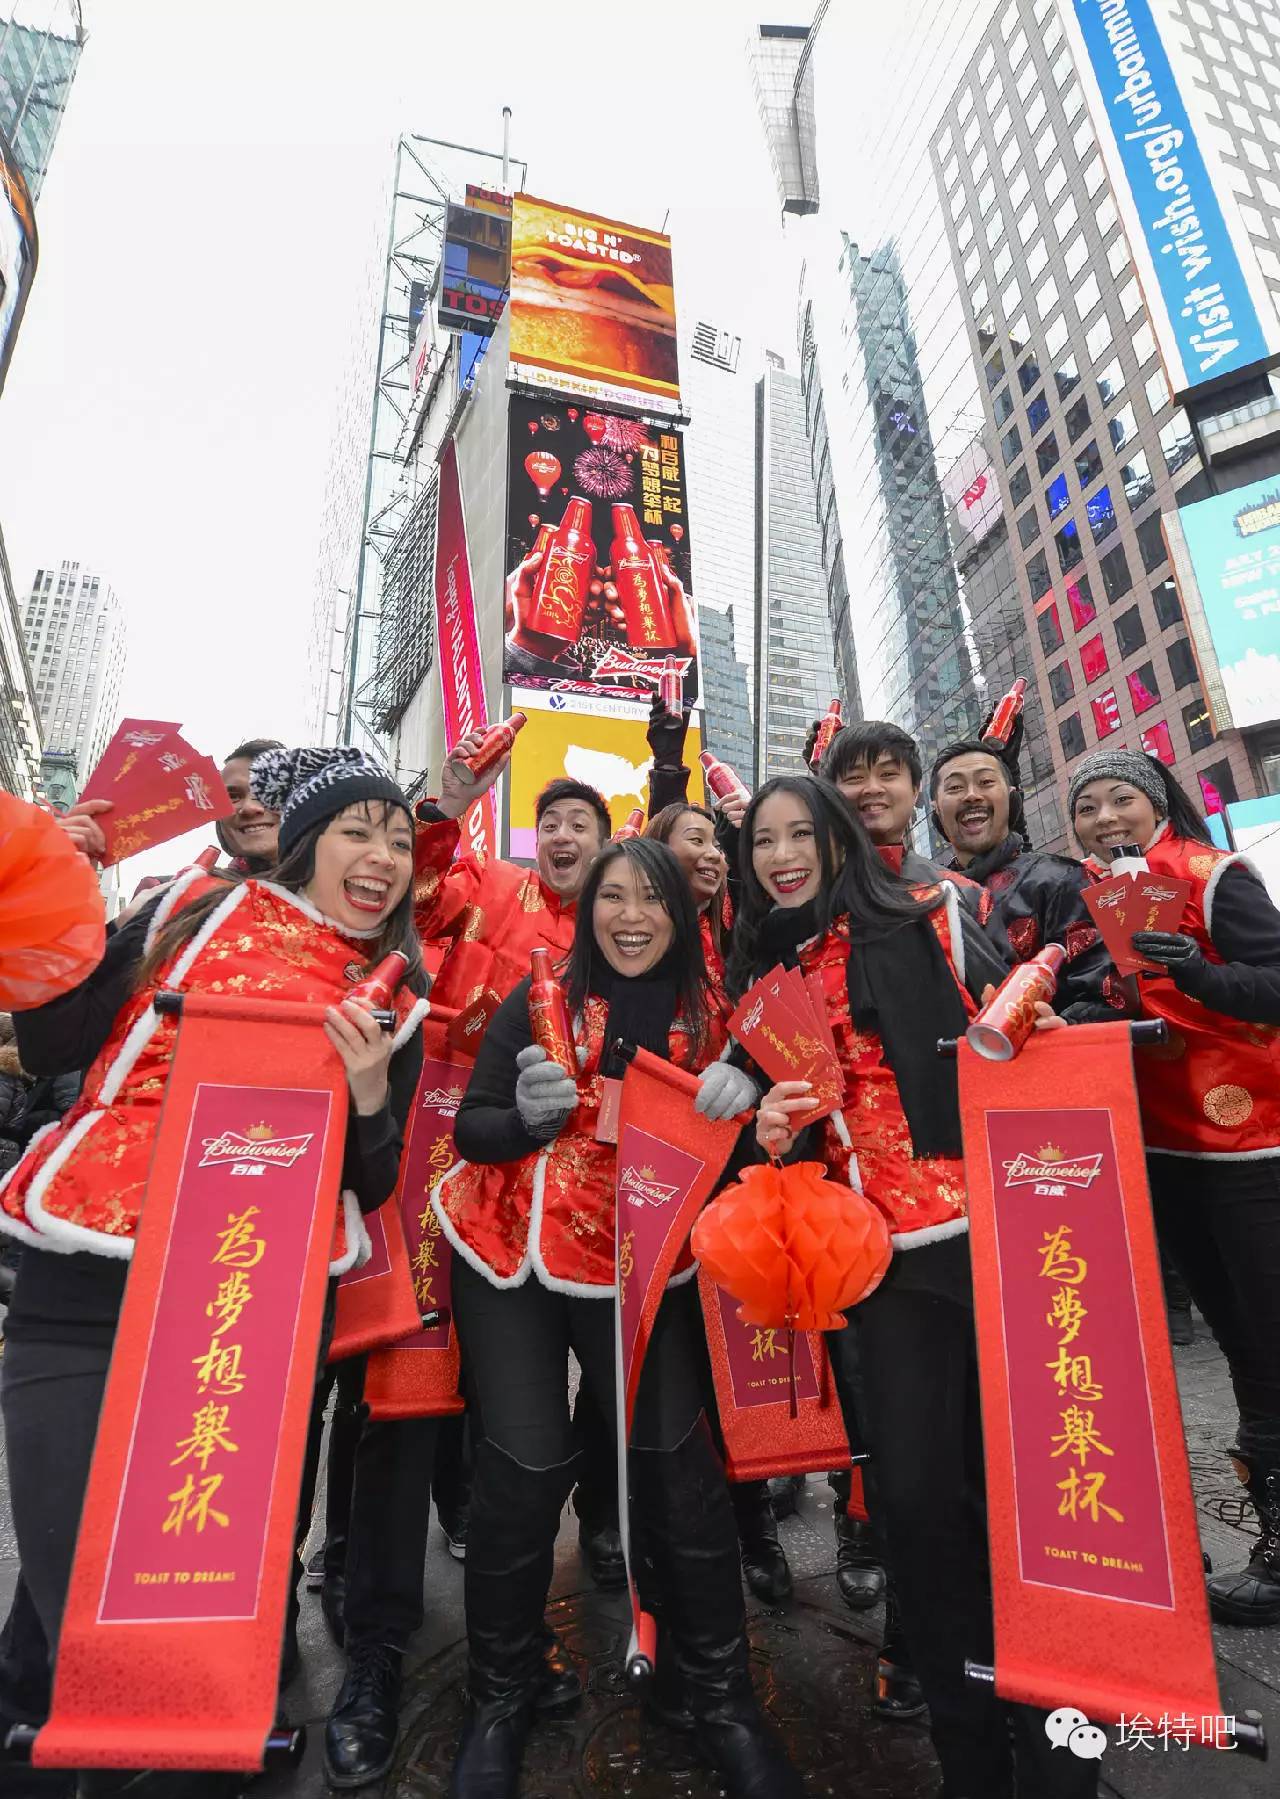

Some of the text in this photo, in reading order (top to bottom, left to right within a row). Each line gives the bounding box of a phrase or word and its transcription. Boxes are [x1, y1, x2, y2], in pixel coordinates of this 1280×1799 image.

[1181, 282, 1239, 373] Visit
[202, 1138, 308, 1157] Budweiser
[230, 1163, 268, 1176] 百威
[1002, 1160, 1102, 1178] Budweiser
[621, 1168, 673, 1203] Budweiser
[1034, 1184, 1066, 1196] 百威
[1044, 1546, 1078, 1561] TOAST
[1081, 1552, 1098, 1565] TO
[134, 1572, 170, 1585] TOAST
[173, 1572, 190, 1583] TO
